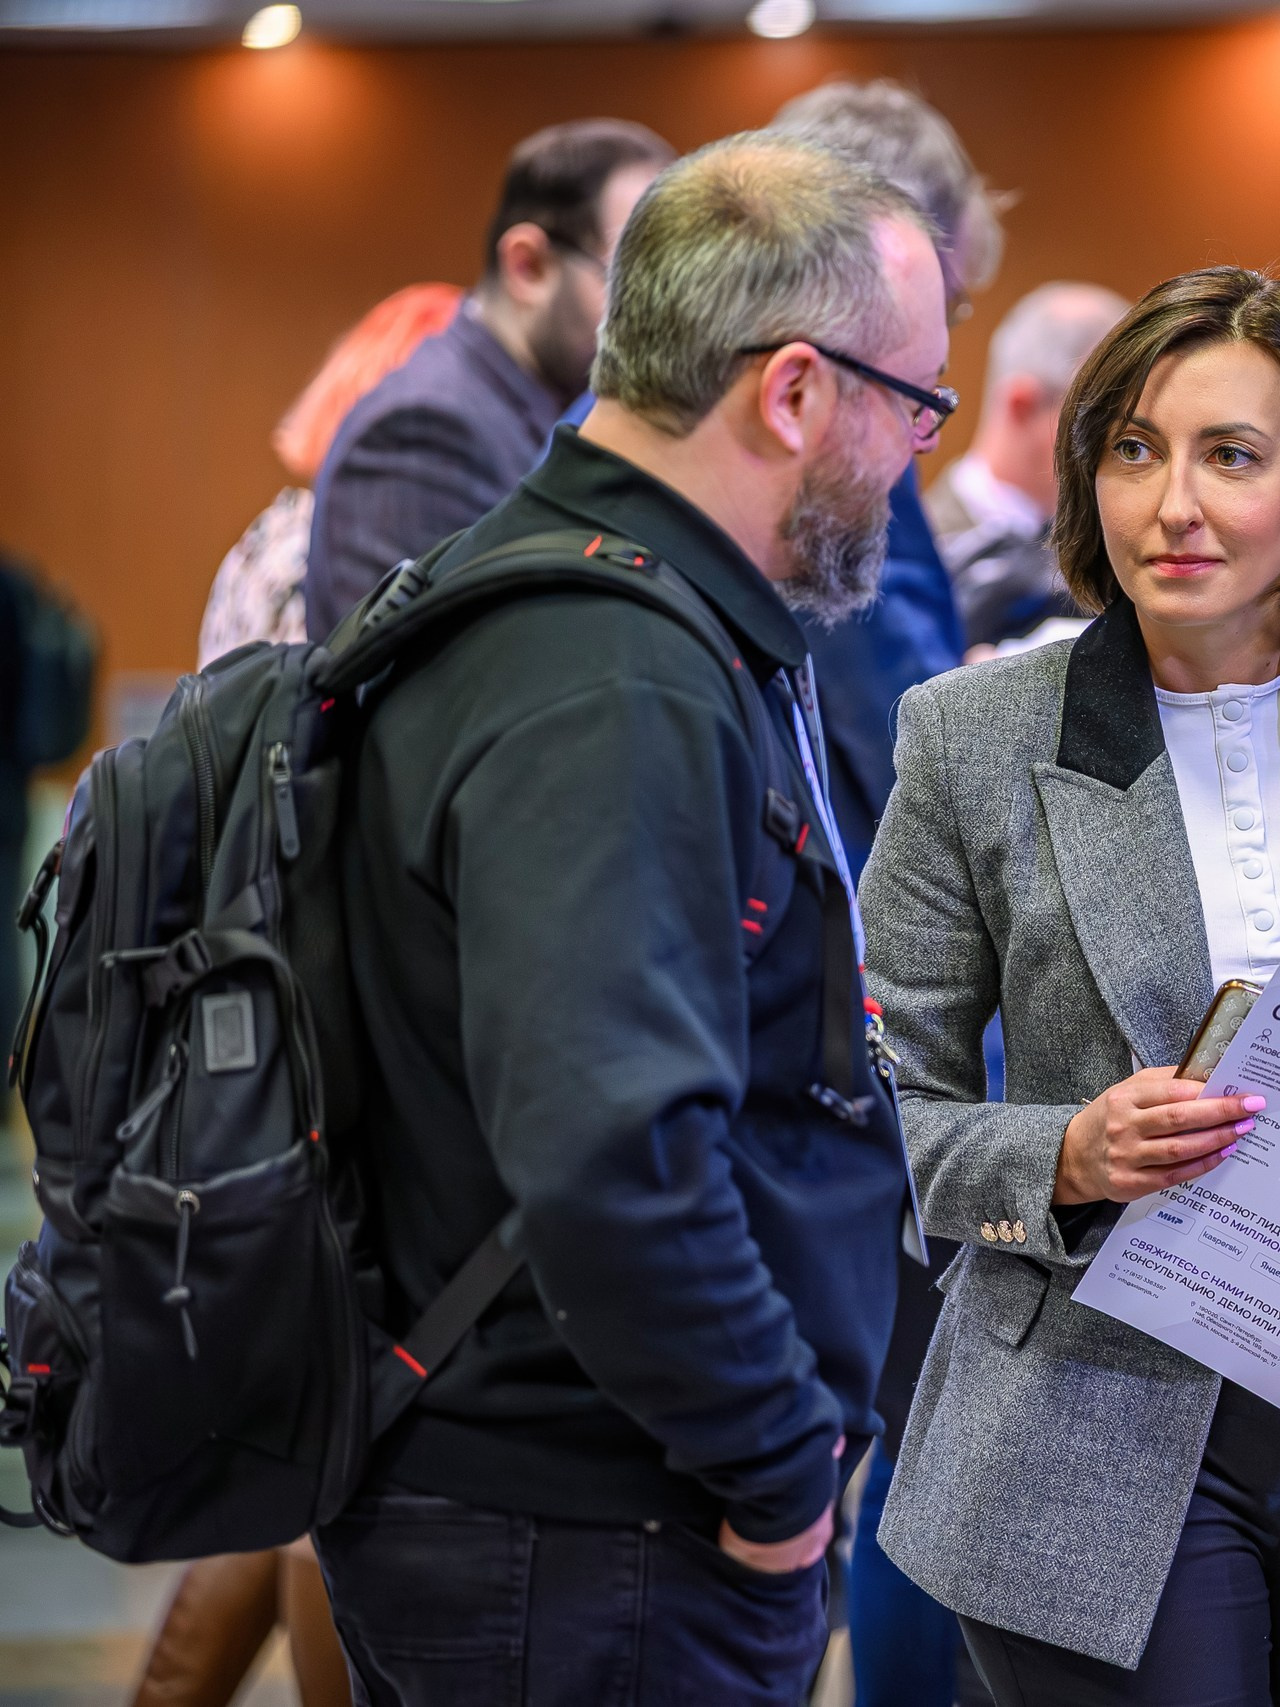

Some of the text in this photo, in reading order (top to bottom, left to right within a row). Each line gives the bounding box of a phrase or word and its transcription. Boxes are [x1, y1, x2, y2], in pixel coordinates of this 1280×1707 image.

[1157, 1210, 1184, 1226] МИР
[1159, 1189, 1169, 1197] И
[1169, 1191, 1208, 1214] БОЛЕЕ
[1208, 1208, 1230, 1224] 100
[1192, 1186, 1258, 1221] ДОВЕРЯЮТ
[1202, 1230, 1243, 1256] kaspersky
[1130, 1237, 1199, 1275] СВЯЖИТЕСЬ
[1210, 1275, 1245, 1299] НАМИ
[1243, 1293, 1255, 1304] И
[1121, 1249, 1215, 1302] КОНСУЛЬТАЦИЮ,
[1217, 1296, 1252, 1319] ДЕМО
[1252, 1315, 1277, 1334] ИЛИ
[1238, 1343, 1261, 1359] Донской
